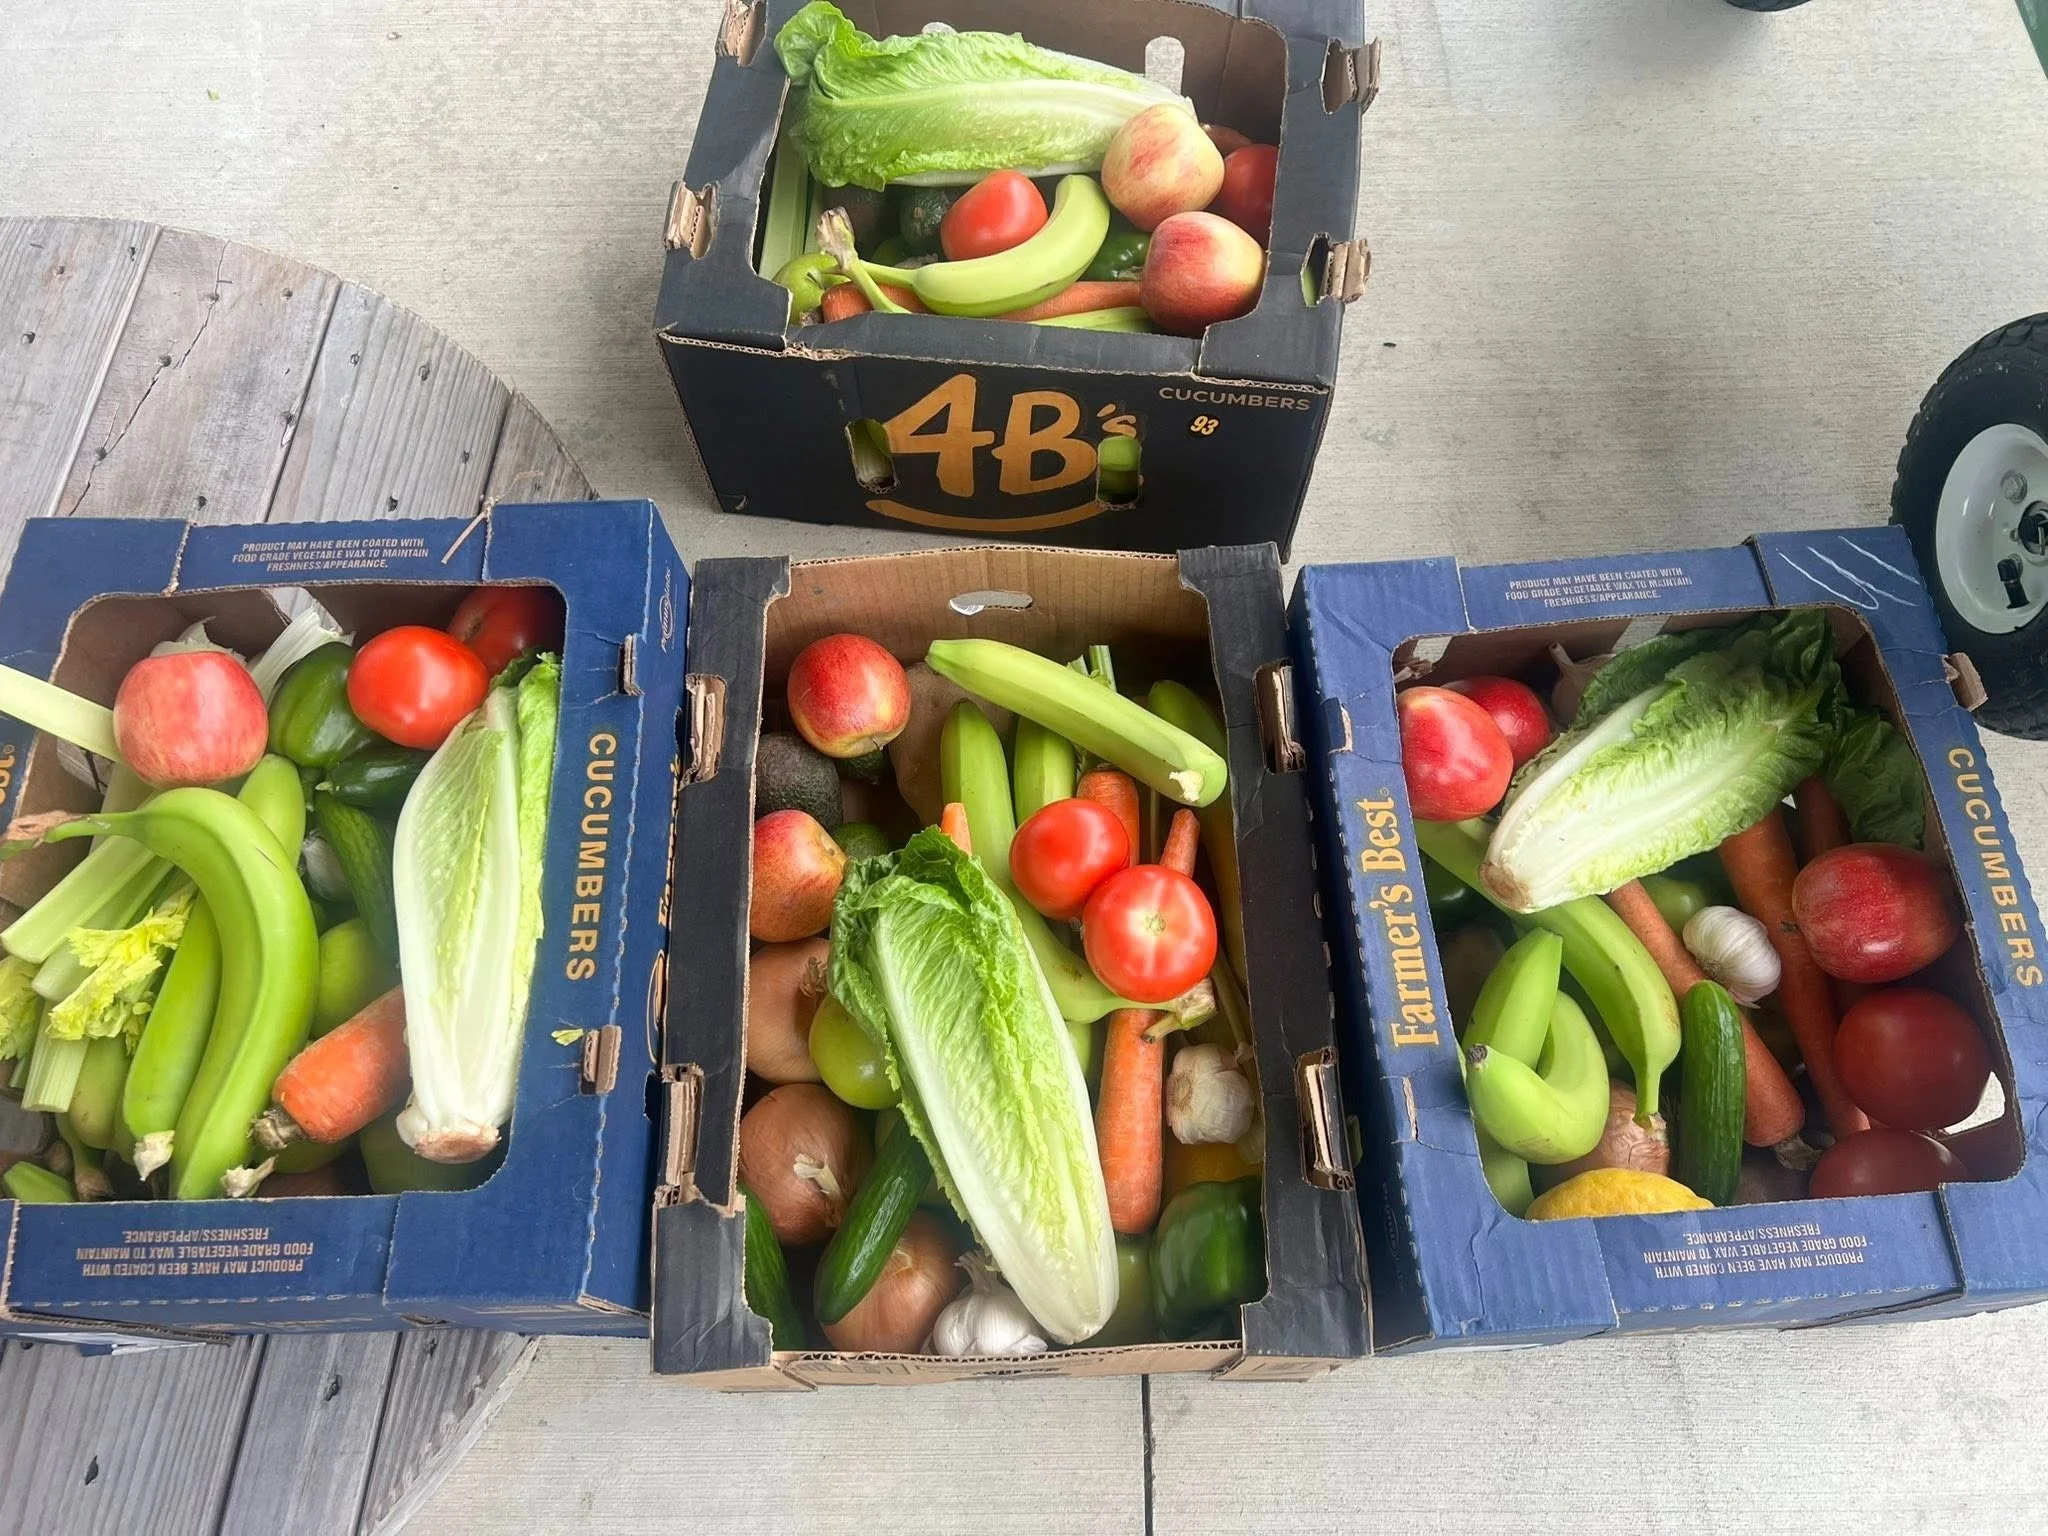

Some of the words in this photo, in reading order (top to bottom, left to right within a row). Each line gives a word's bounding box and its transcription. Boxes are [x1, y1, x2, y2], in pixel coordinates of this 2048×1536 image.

[1158, 386, 1312, 411] CUCUMBERS
[1190, 415, 1220, 436] 93
[242, 542, 285, 551] PRODUCT
[310, 541, 333, 549] HAVE
[336, 540, 360, 548] BEEN
[362, 539, 398, 547] COATED
[400, 538, 424, 547] WITH
[232, 554, 256, 563] FOOD
[259, 553, 290, 562] GRADE
[293, 551, 342, 560] VEGETABLE
[345, 550, 365, 558] WAX
[368, 550, 380, 558] TO
[382, 549, 429, 558] MAINTAIN
[266, 560, 388, 572] FRESHNESS/APPEARANCE.
[1509, 578, 1550, 589] PRODUCT
[1552, 576, 1572, 585] MAY
[1574, 574, 1598, 584] HAVE
[1599, 572, 1622, 582] BEEN
[1624, 570, 1658, 579] COATED
[1659, 568, 1683, 577] WITH
[1505, 590, 1529, 600] FOOD
[1531, 587, 1562, 598] GRADE
[1563, 583, 1613, 595] VEGETABLE
[1613, 582, 1634, 590] WAX
[1636, 580, 1647, 588] TO
[1649, 577, 1692, 587] MAINTAIN
[1544, 590, 1661, 608] FRESHNESS/APPEARANCE.
[565, 732, 617, 981] CUCUMBERS
[1948, 747, 2043, 987] CUCUMBERS
[1369, 884, 1440, 1047] Farmer's
[122, 1228, 269, 1243] FRESHNESS/APPEARANCE.
[1683, 1223, 1821, 1245] FRESHNESS/APPEARANCE.
[1741, 1240, 1798, 1256] VEGETABLE
[1802, 1238, 1837, 1251] GRADE
[1839, 1235, 1868, 1248] FOOD
[76, 1247, 130, 1260] MAINTAIN
[133, 1247, 148, 1259] TO
[149, 1247, 175, 1259] WAX
[177, 1245, 239, 1259] VEGETABLE
[241, 1244, 280, 1256] GRADE
[284, 1242, 314, 1255] FOOD
[1699, 1248, 1713, 1260] TO
[1715, 1246, 1739, 1259] WAX
[1643, 1249, 1697, 1264] MAINTAIN
[1789, 1255, 1812, 1268] MAY
[1815, 1251, 1864, 1266] PRODUCT
[82, 1263, 110, 1276] WITH
[113, 1263, 155, 1276] COATED
[159, 1262, 189, 1274] BEEN
[192, 1262, 220, 1274] HAVE
[222, 1261, 247, 1274] MAY
[250, 1259, 304, 1272] PRODUCT
[1686, 1263, 1725, 1276] COATED
[1728, 1260, 1755, 1273] BEEN
[1759, 1257, 1787, 1270] HAVE
[1655, 1265, 1683, 1278] WITH
